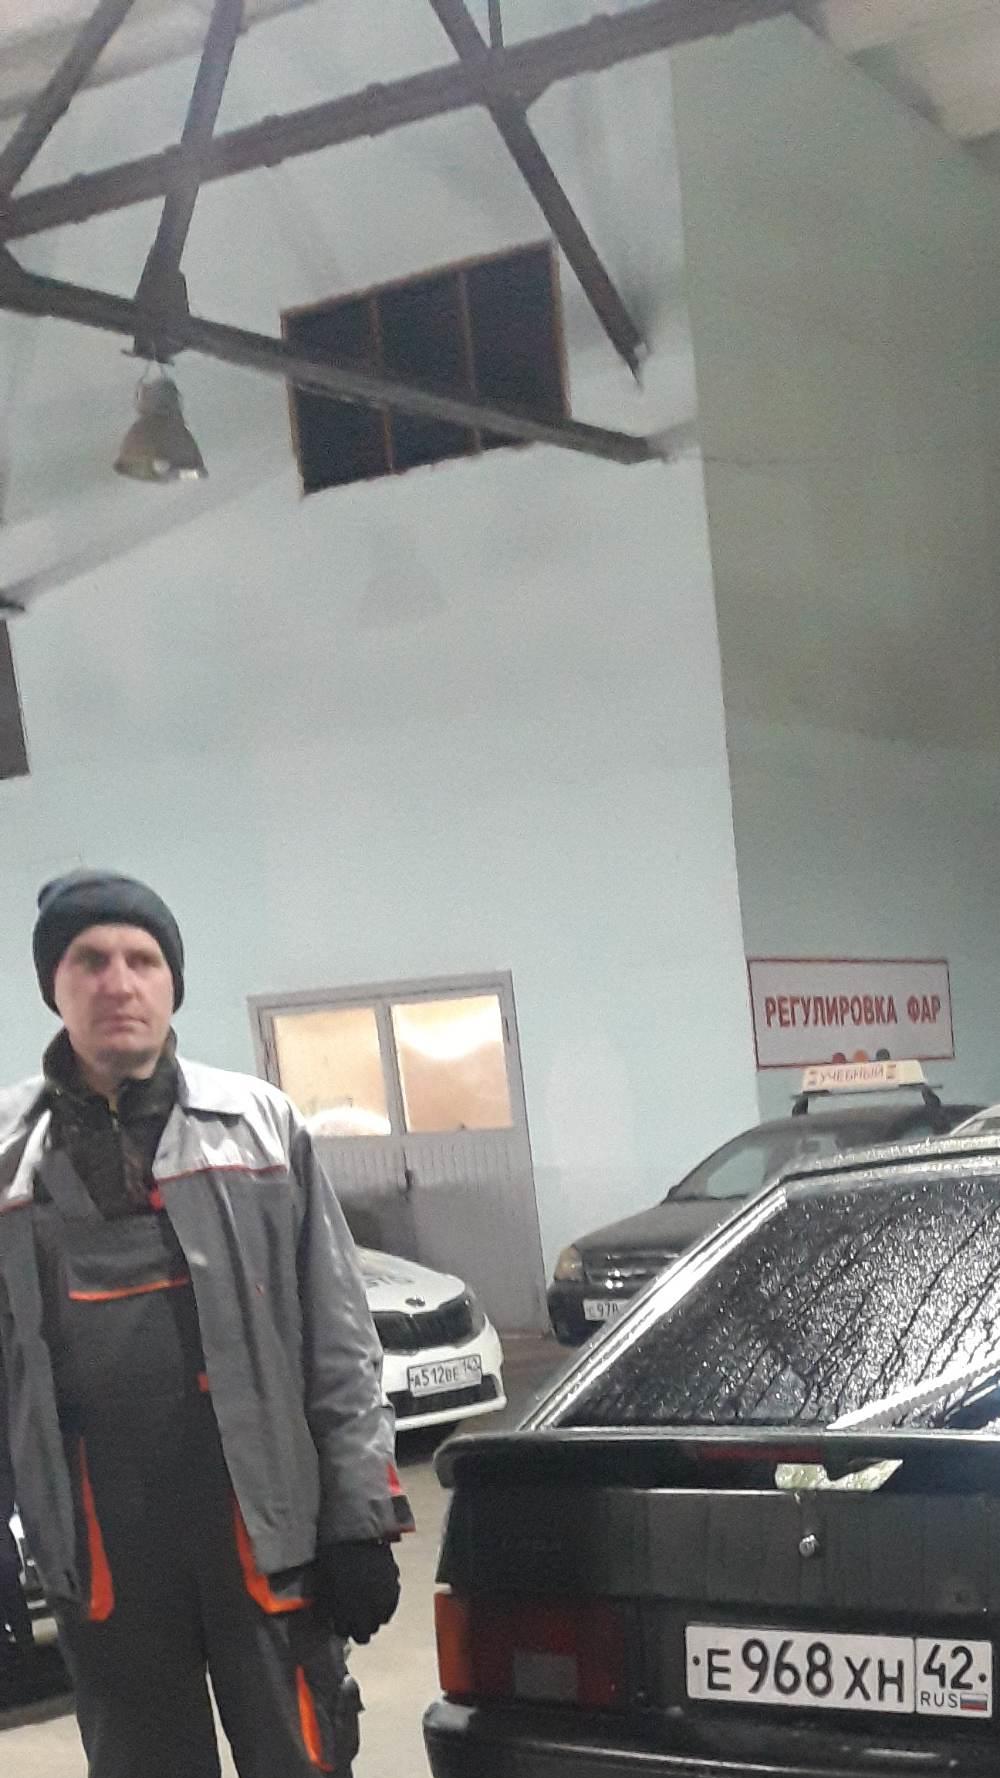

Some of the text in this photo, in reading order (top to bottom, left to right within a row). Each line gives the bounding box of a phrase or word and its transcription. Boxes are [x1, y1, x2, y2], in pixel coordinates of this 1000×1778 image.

[764, 994, 941, 1028] РЕГУЛИРОВКА ФАР
[820, 1063, 884, 1082] УЧЕБНЫЙ
[706, 1638, 974, 1704] Е968ХН 42
[920, 1691, 959, 1709] RUS
